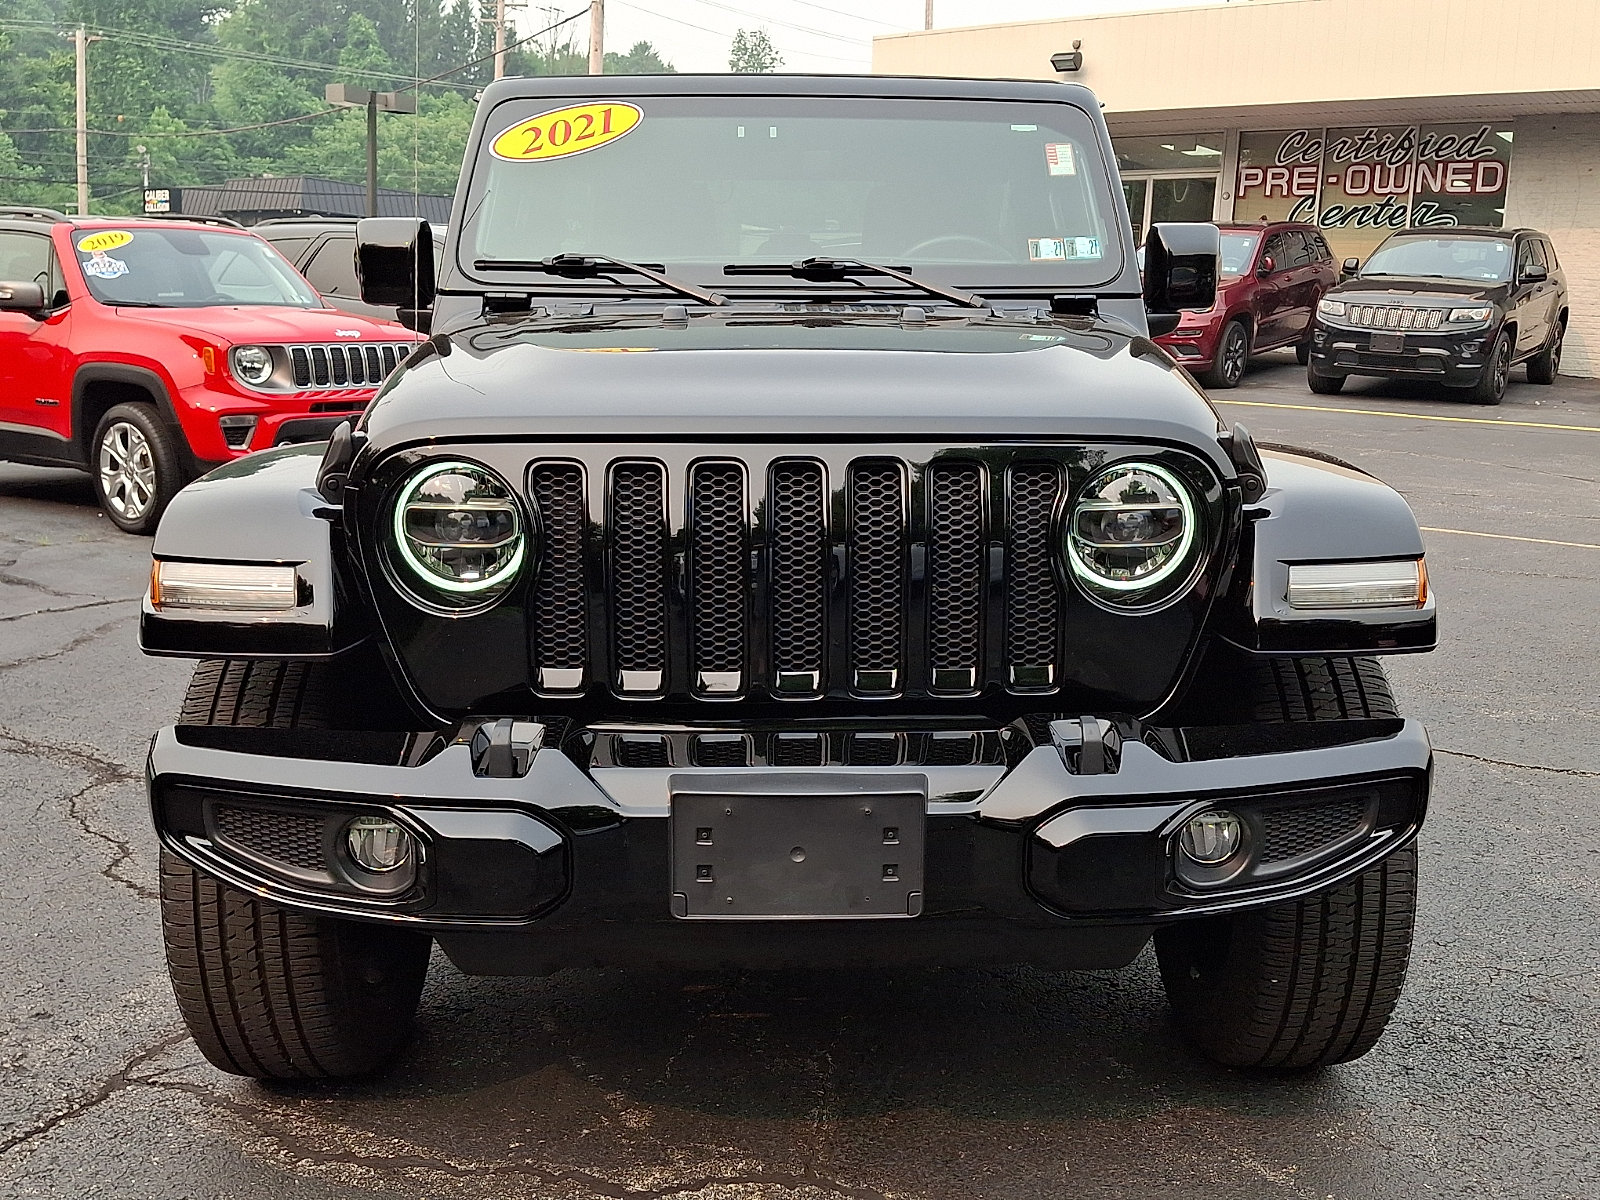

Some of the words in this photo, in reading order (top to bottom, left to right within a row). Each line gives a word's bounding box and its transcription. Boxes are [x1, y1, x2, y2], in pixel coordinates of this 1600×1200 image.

[521, 107, 615, 155] 2021
[1275, 125, 1497, 167] Certified
[1238, 161, 1505, 197] PRE-OWNED
[1286, 195, 1459, 229] Center
[87, 233, 124, 250] 2019
[335, 329, 361, 338] Jeep
